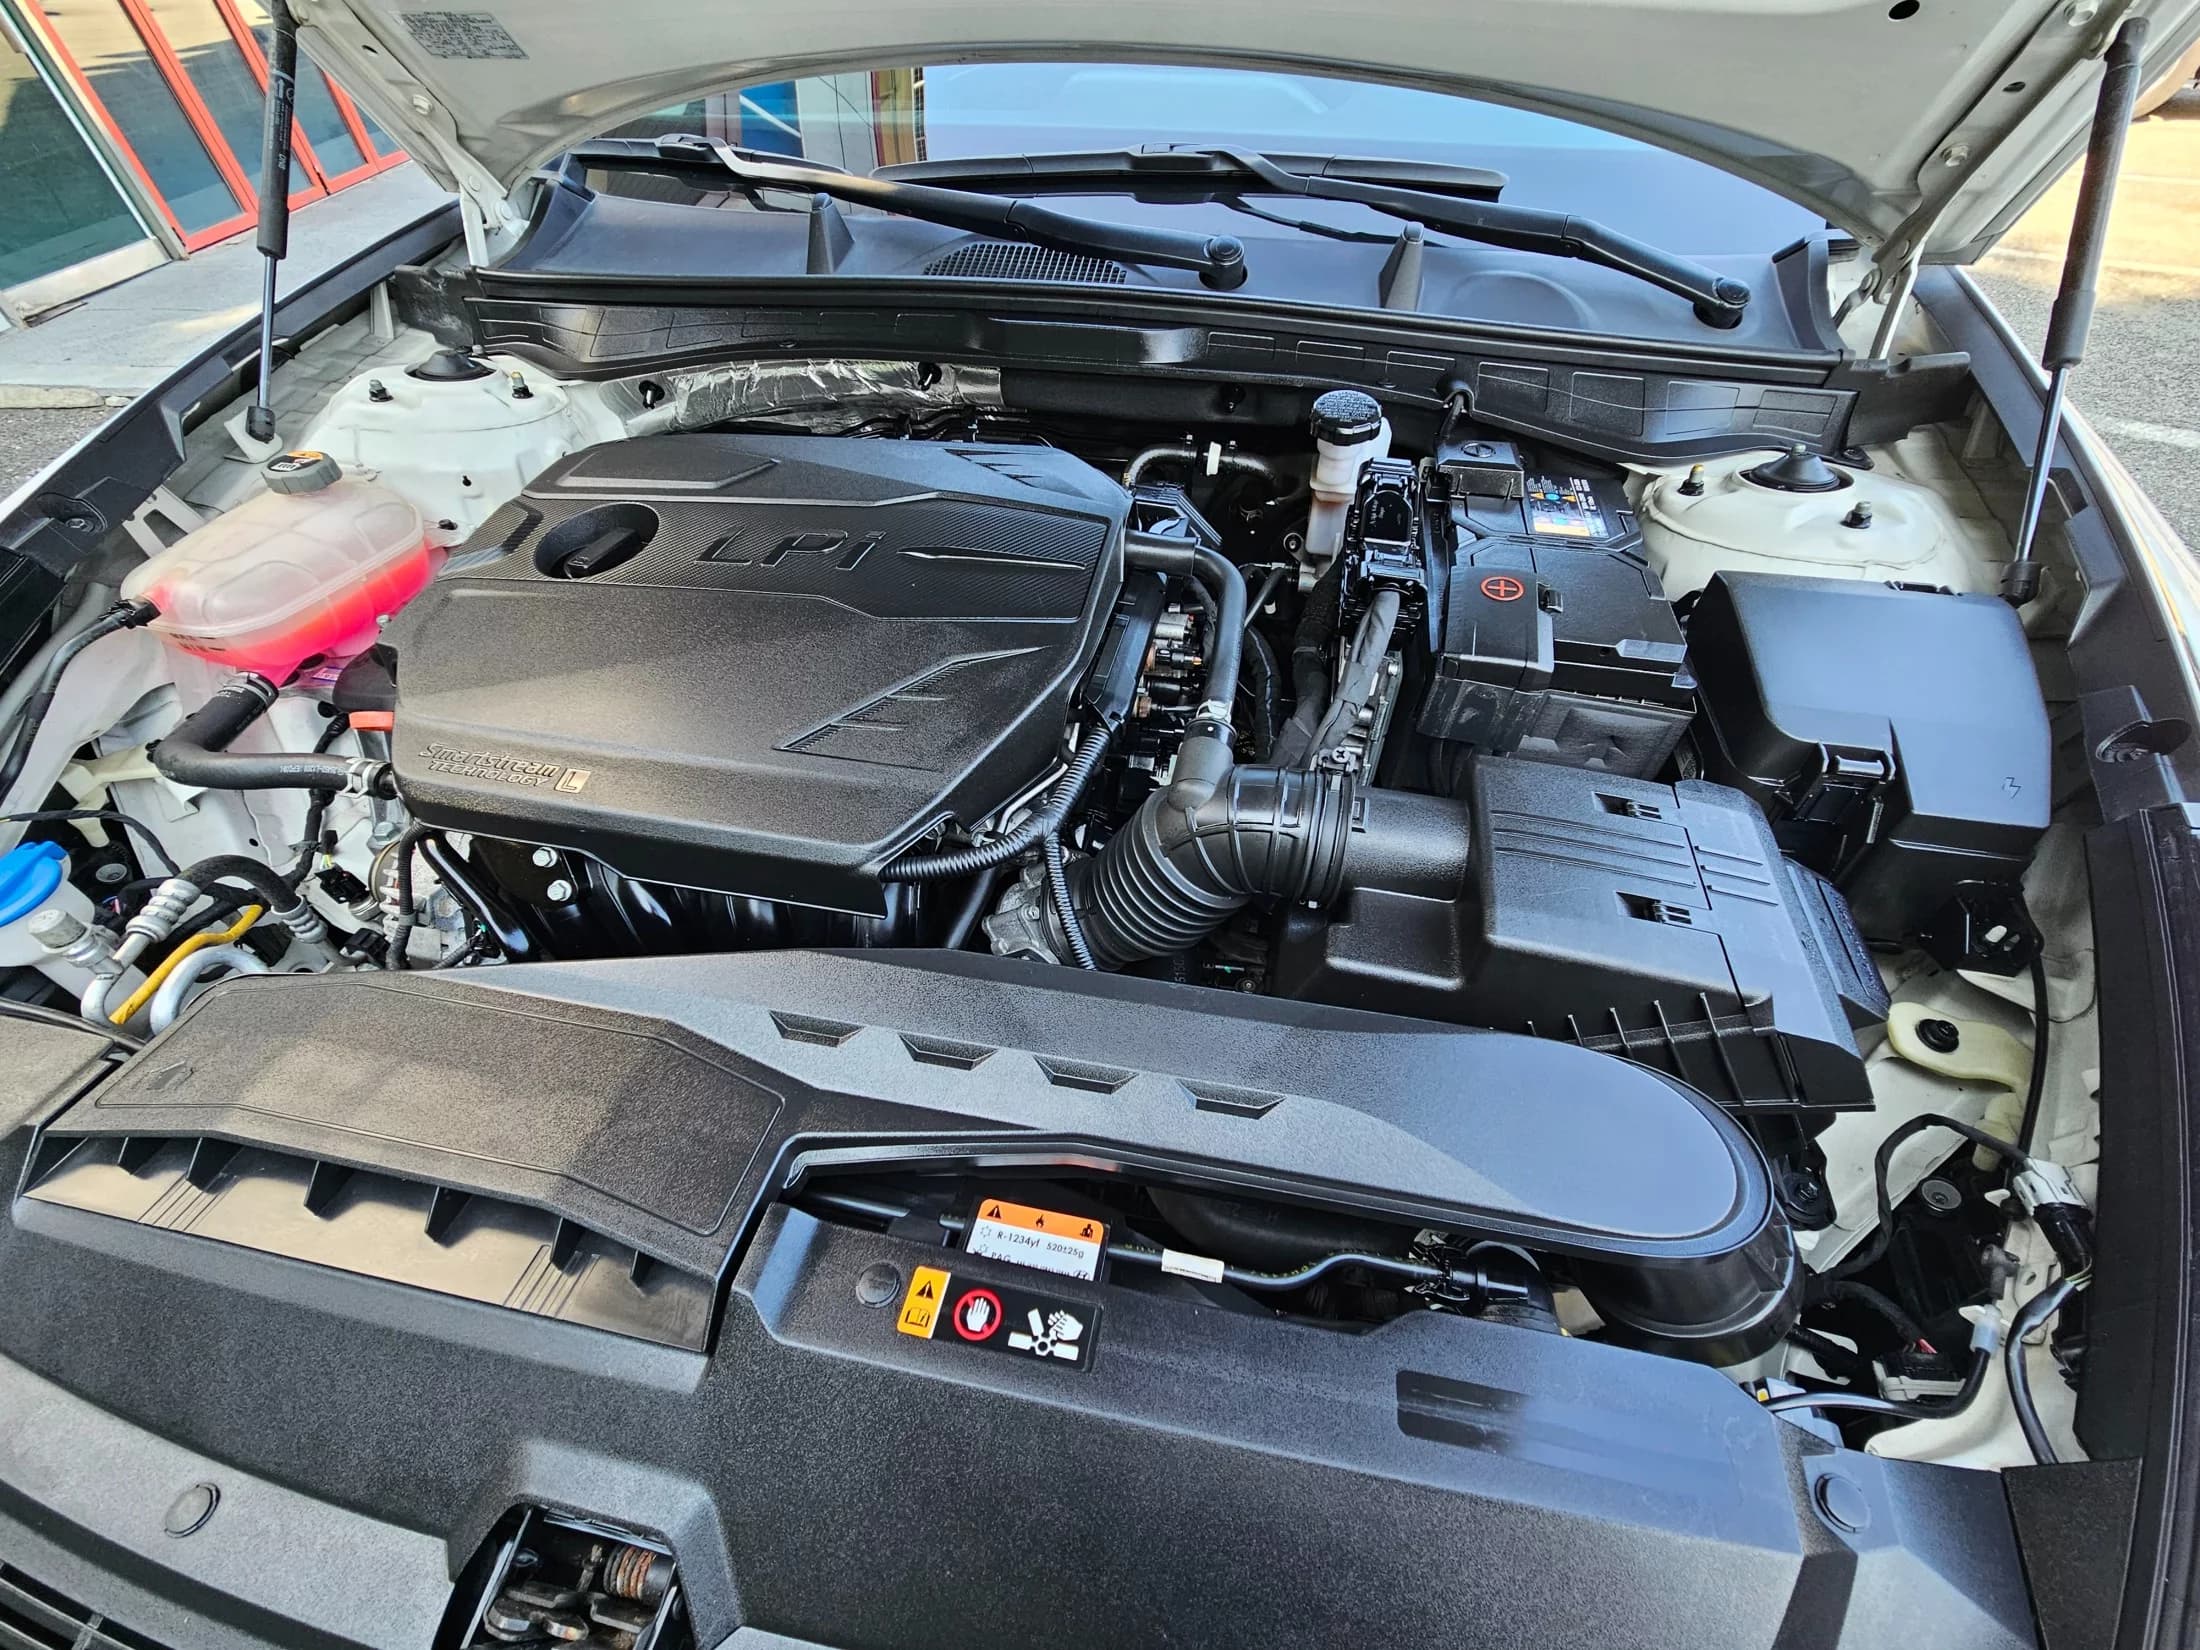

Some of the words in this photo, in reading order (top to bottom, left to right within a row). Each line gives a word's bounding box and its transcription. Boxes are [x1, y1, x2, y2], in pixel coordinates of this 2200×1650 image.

[695, 526, 886, 570] LPi
[419, 743, 561, 777] Smartstream
[428, 760, 549, 787] TECHNOLOGY
[997, 1231, 1040, 1248] R-1234yf
[1046, 1242, 1085, 1259] 520±25g
